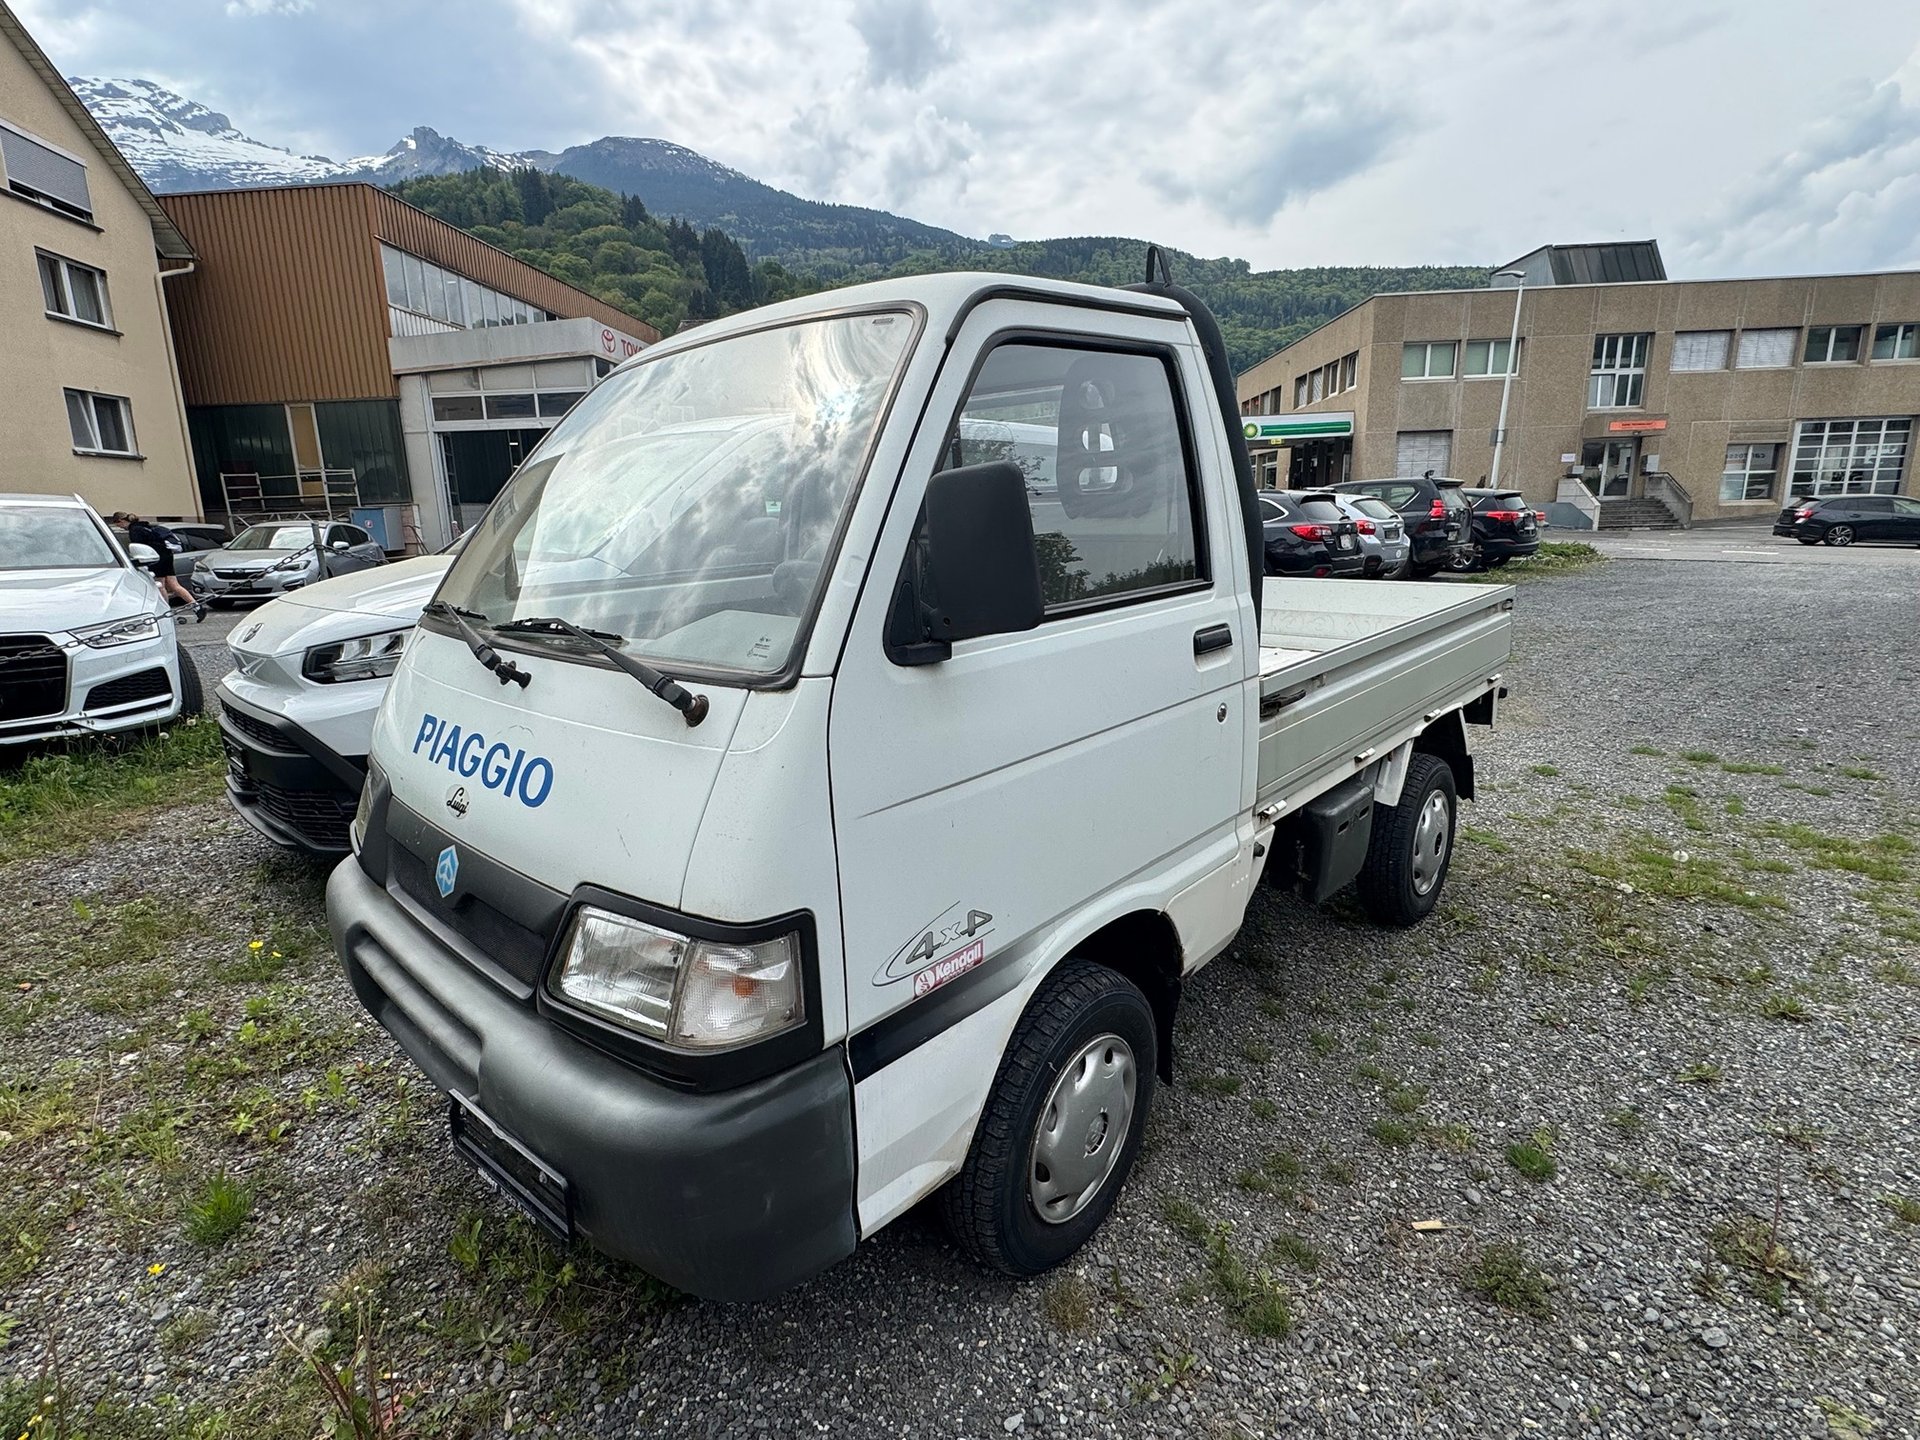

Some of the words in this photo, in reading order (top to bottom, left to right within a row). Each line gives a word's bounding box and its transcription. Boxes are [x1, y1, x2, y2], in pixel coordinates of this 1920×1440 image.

[621, 339, 643, 356] TOY
[412, 713, 554, 808] PIAGGIO
[446, 787, 469, 817] Luigi
[906, 909, 993, 964] 4x4
[936, 943, 981, 981] Kendall
